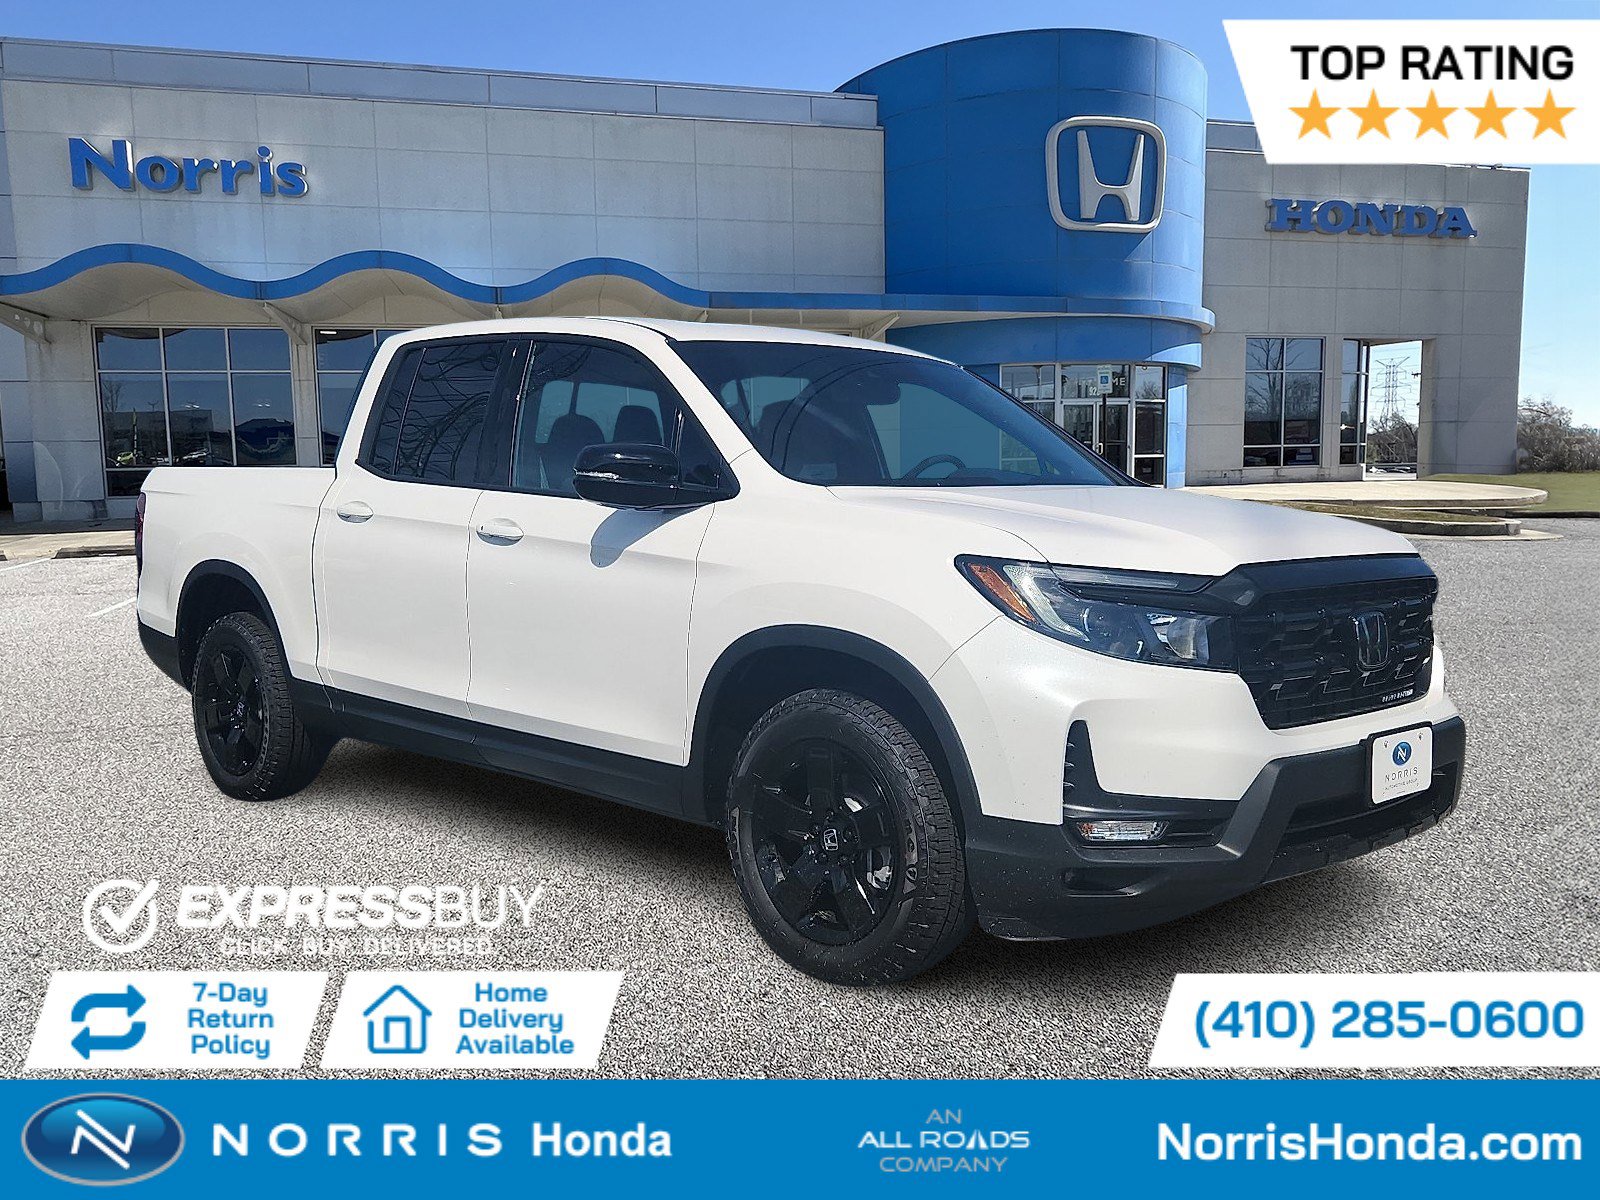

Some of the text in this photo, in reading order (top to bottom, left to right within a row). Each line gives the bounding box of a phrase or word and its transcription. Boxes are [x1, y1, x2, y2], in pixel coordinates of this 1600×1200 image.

[68, 137, 308, 197] Norris
[1266, 198, 1477, 239] HONDA
[1385, 766, 1418, 783] NORRIS
